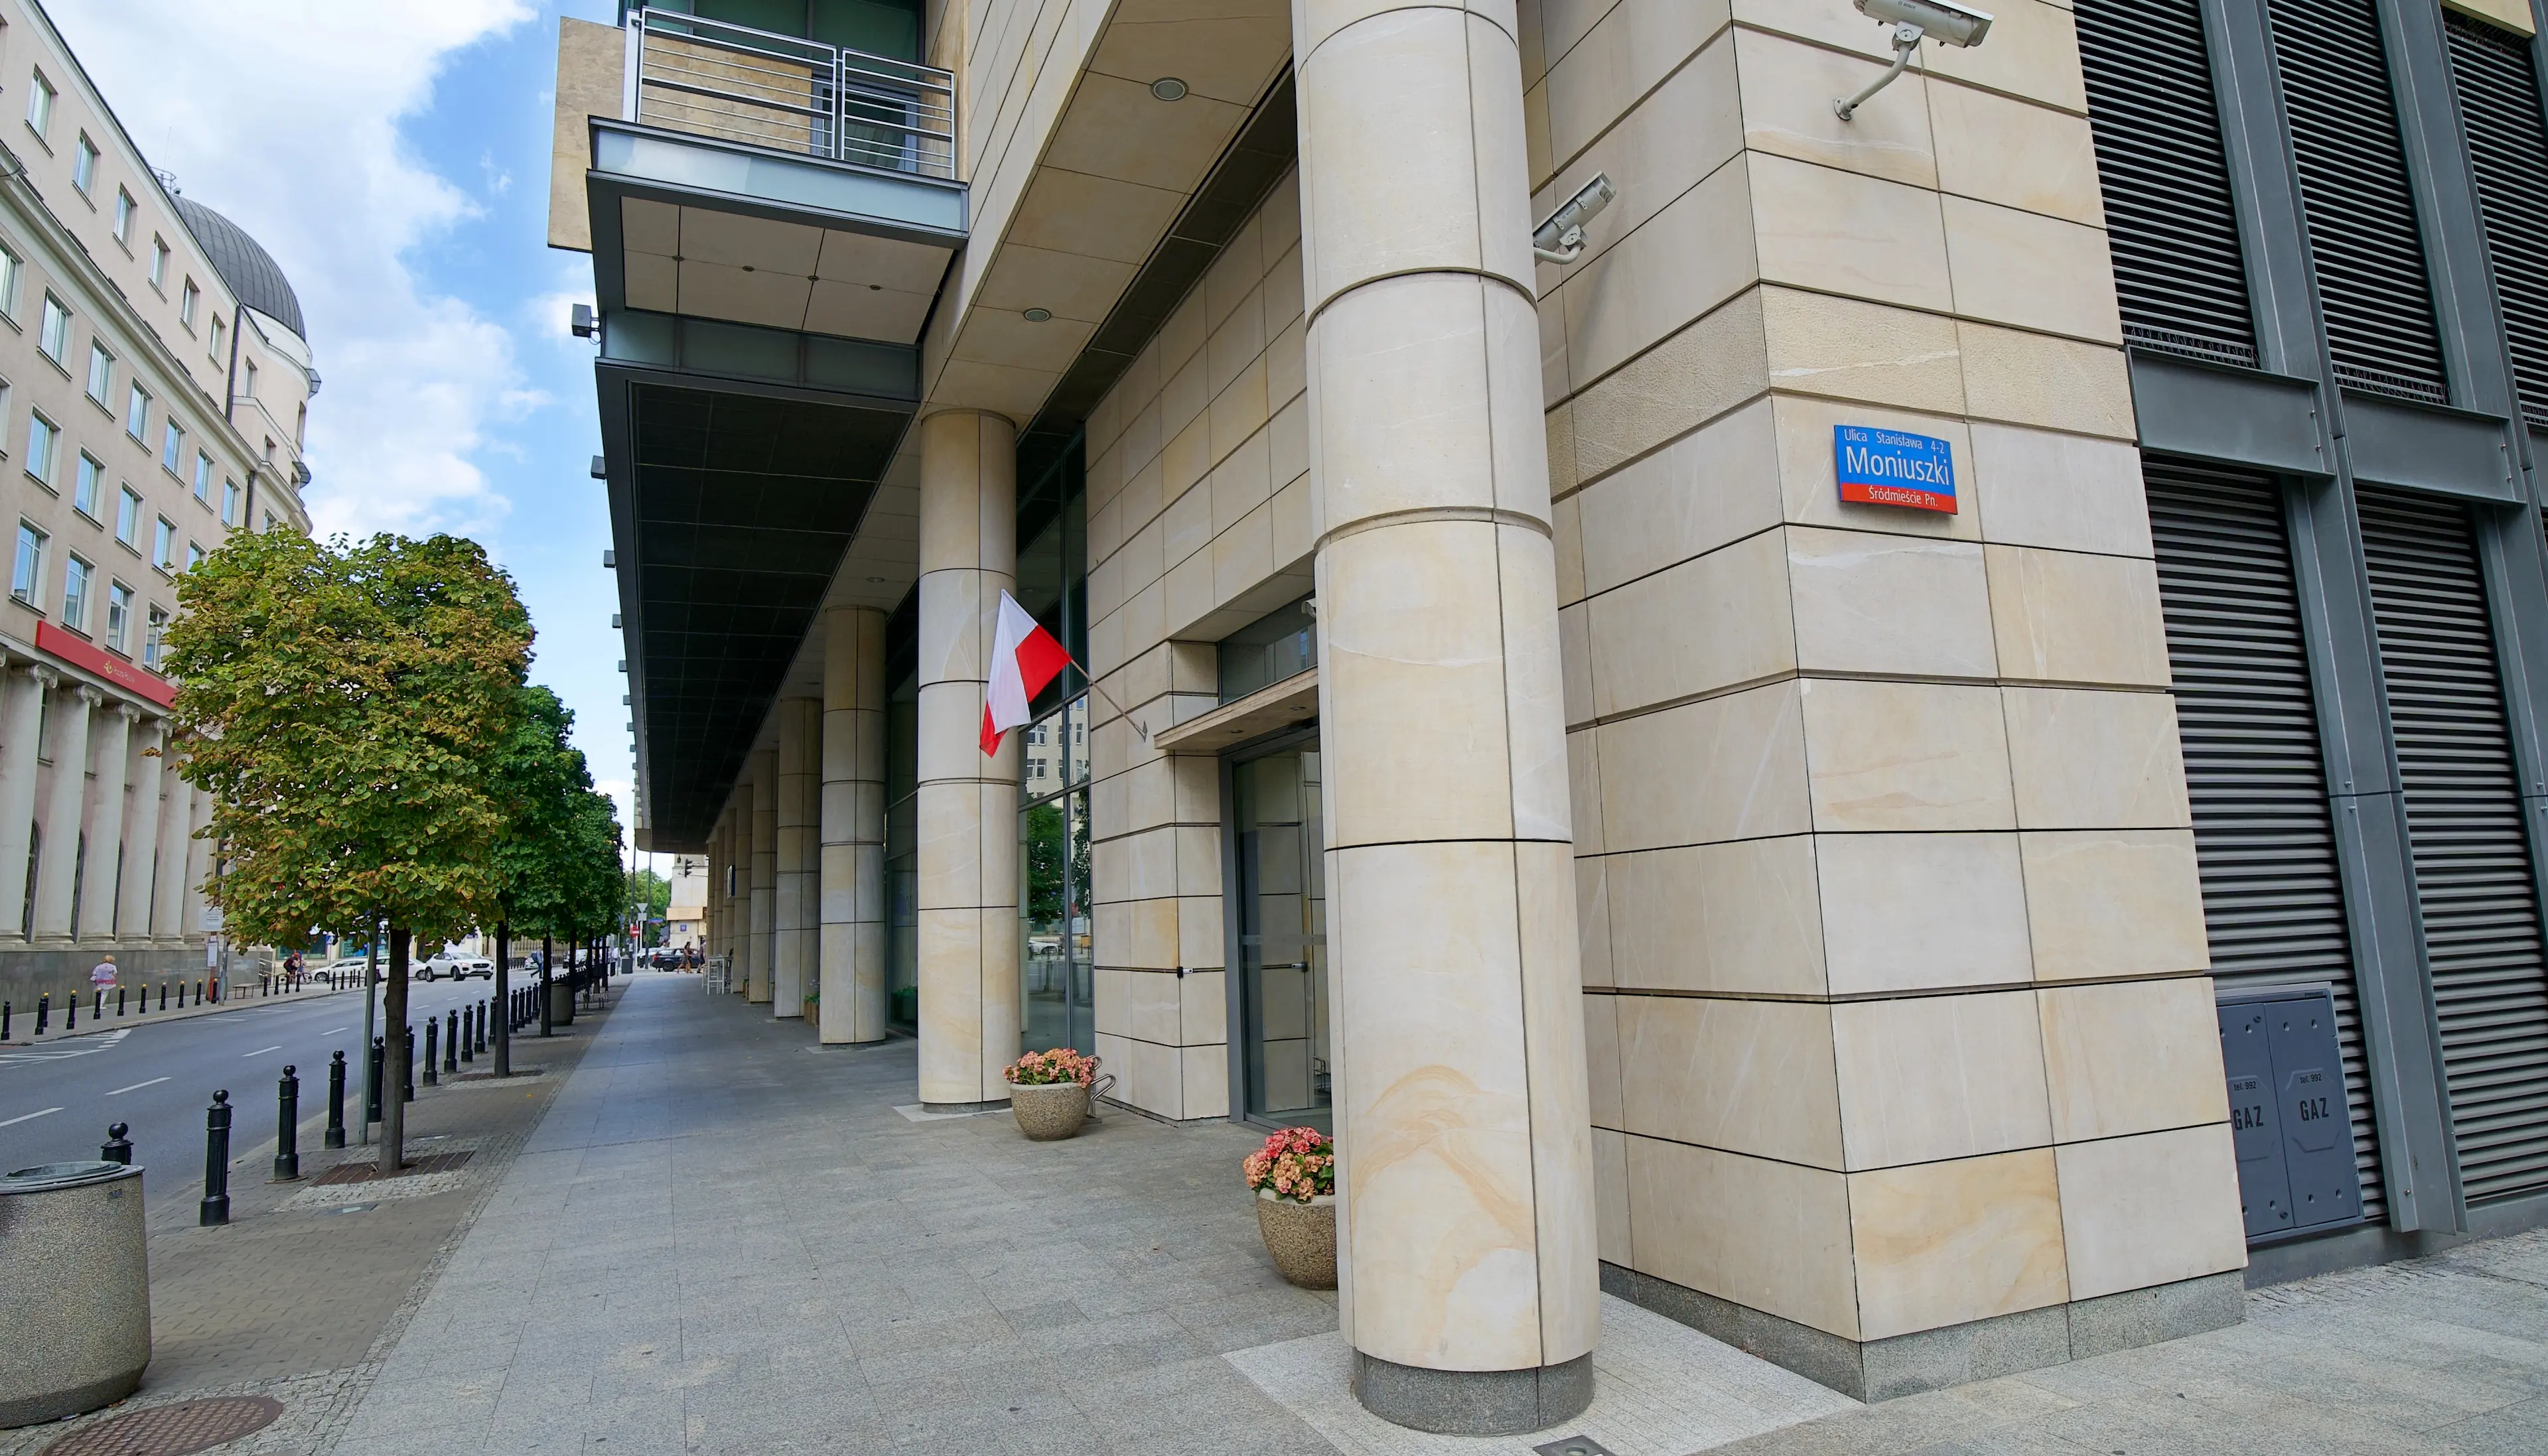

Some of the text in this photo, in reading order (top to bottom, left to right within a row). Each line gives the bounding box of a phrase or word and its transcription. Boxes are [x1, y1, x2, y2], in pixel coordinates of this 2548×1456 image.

[1844, 429, 1944, 454] Ulica Stanisława 4-2
[1846, 446, 1949, 486] Moniuszki
[1869, 486, 1938, 507] Śródmieście Pn.
[2233, 1081, 2256, 1091] tel. 992
[2311, 1073, 2322, 1082] 992
[2233, 1106, 2263, 1130] GAZ
[2300, 1098, 2329, 1121] GAZ
